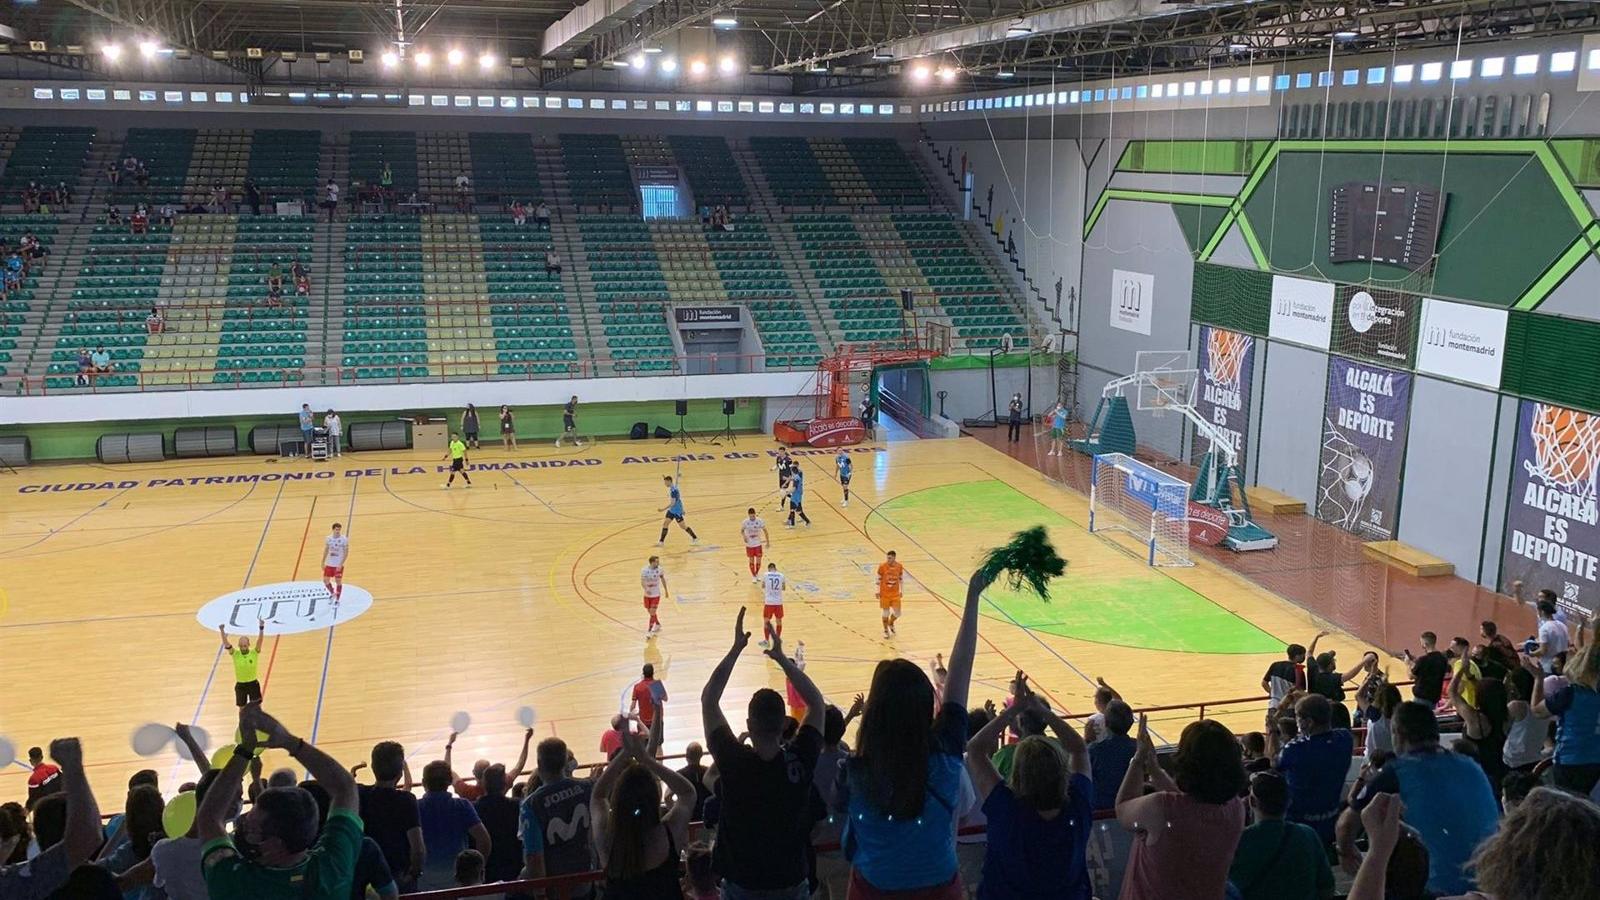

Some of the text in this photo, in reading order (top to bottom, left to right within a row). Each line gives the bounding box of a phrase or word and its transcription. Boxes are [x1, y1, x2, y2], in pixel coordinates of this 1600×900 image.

[1292, 311, 1326, 323] montemadrid
[1366, 312, 1392, 325] deporte
[1368, 301, 1405, 318] integración
[1449, 329, 1481, 344] fundación
[1448, 341, 1496, 357] montemadrid
[1346, 367, 1393, 397] ALCALÁ
[1359, 392, 1376, 415] ES
[1213, 406, 1228, 426] ES
[1338, 407, 1394, 441] DEPORTE
[621, 452, 716, 465] Alcalá
[724, 451, 760, 460] de
[19, 480, 139, 493] CIUDAD
[147, 472, 335, 488] PATRIMONIO
[345, 468, 383, 478] DE
[392, 467, 427, 475] LA
[1544, 514, 1569, 544] ES
[1511, 529, 1599, 582] DEPORTE
[769, 577, 780, 591] 12
